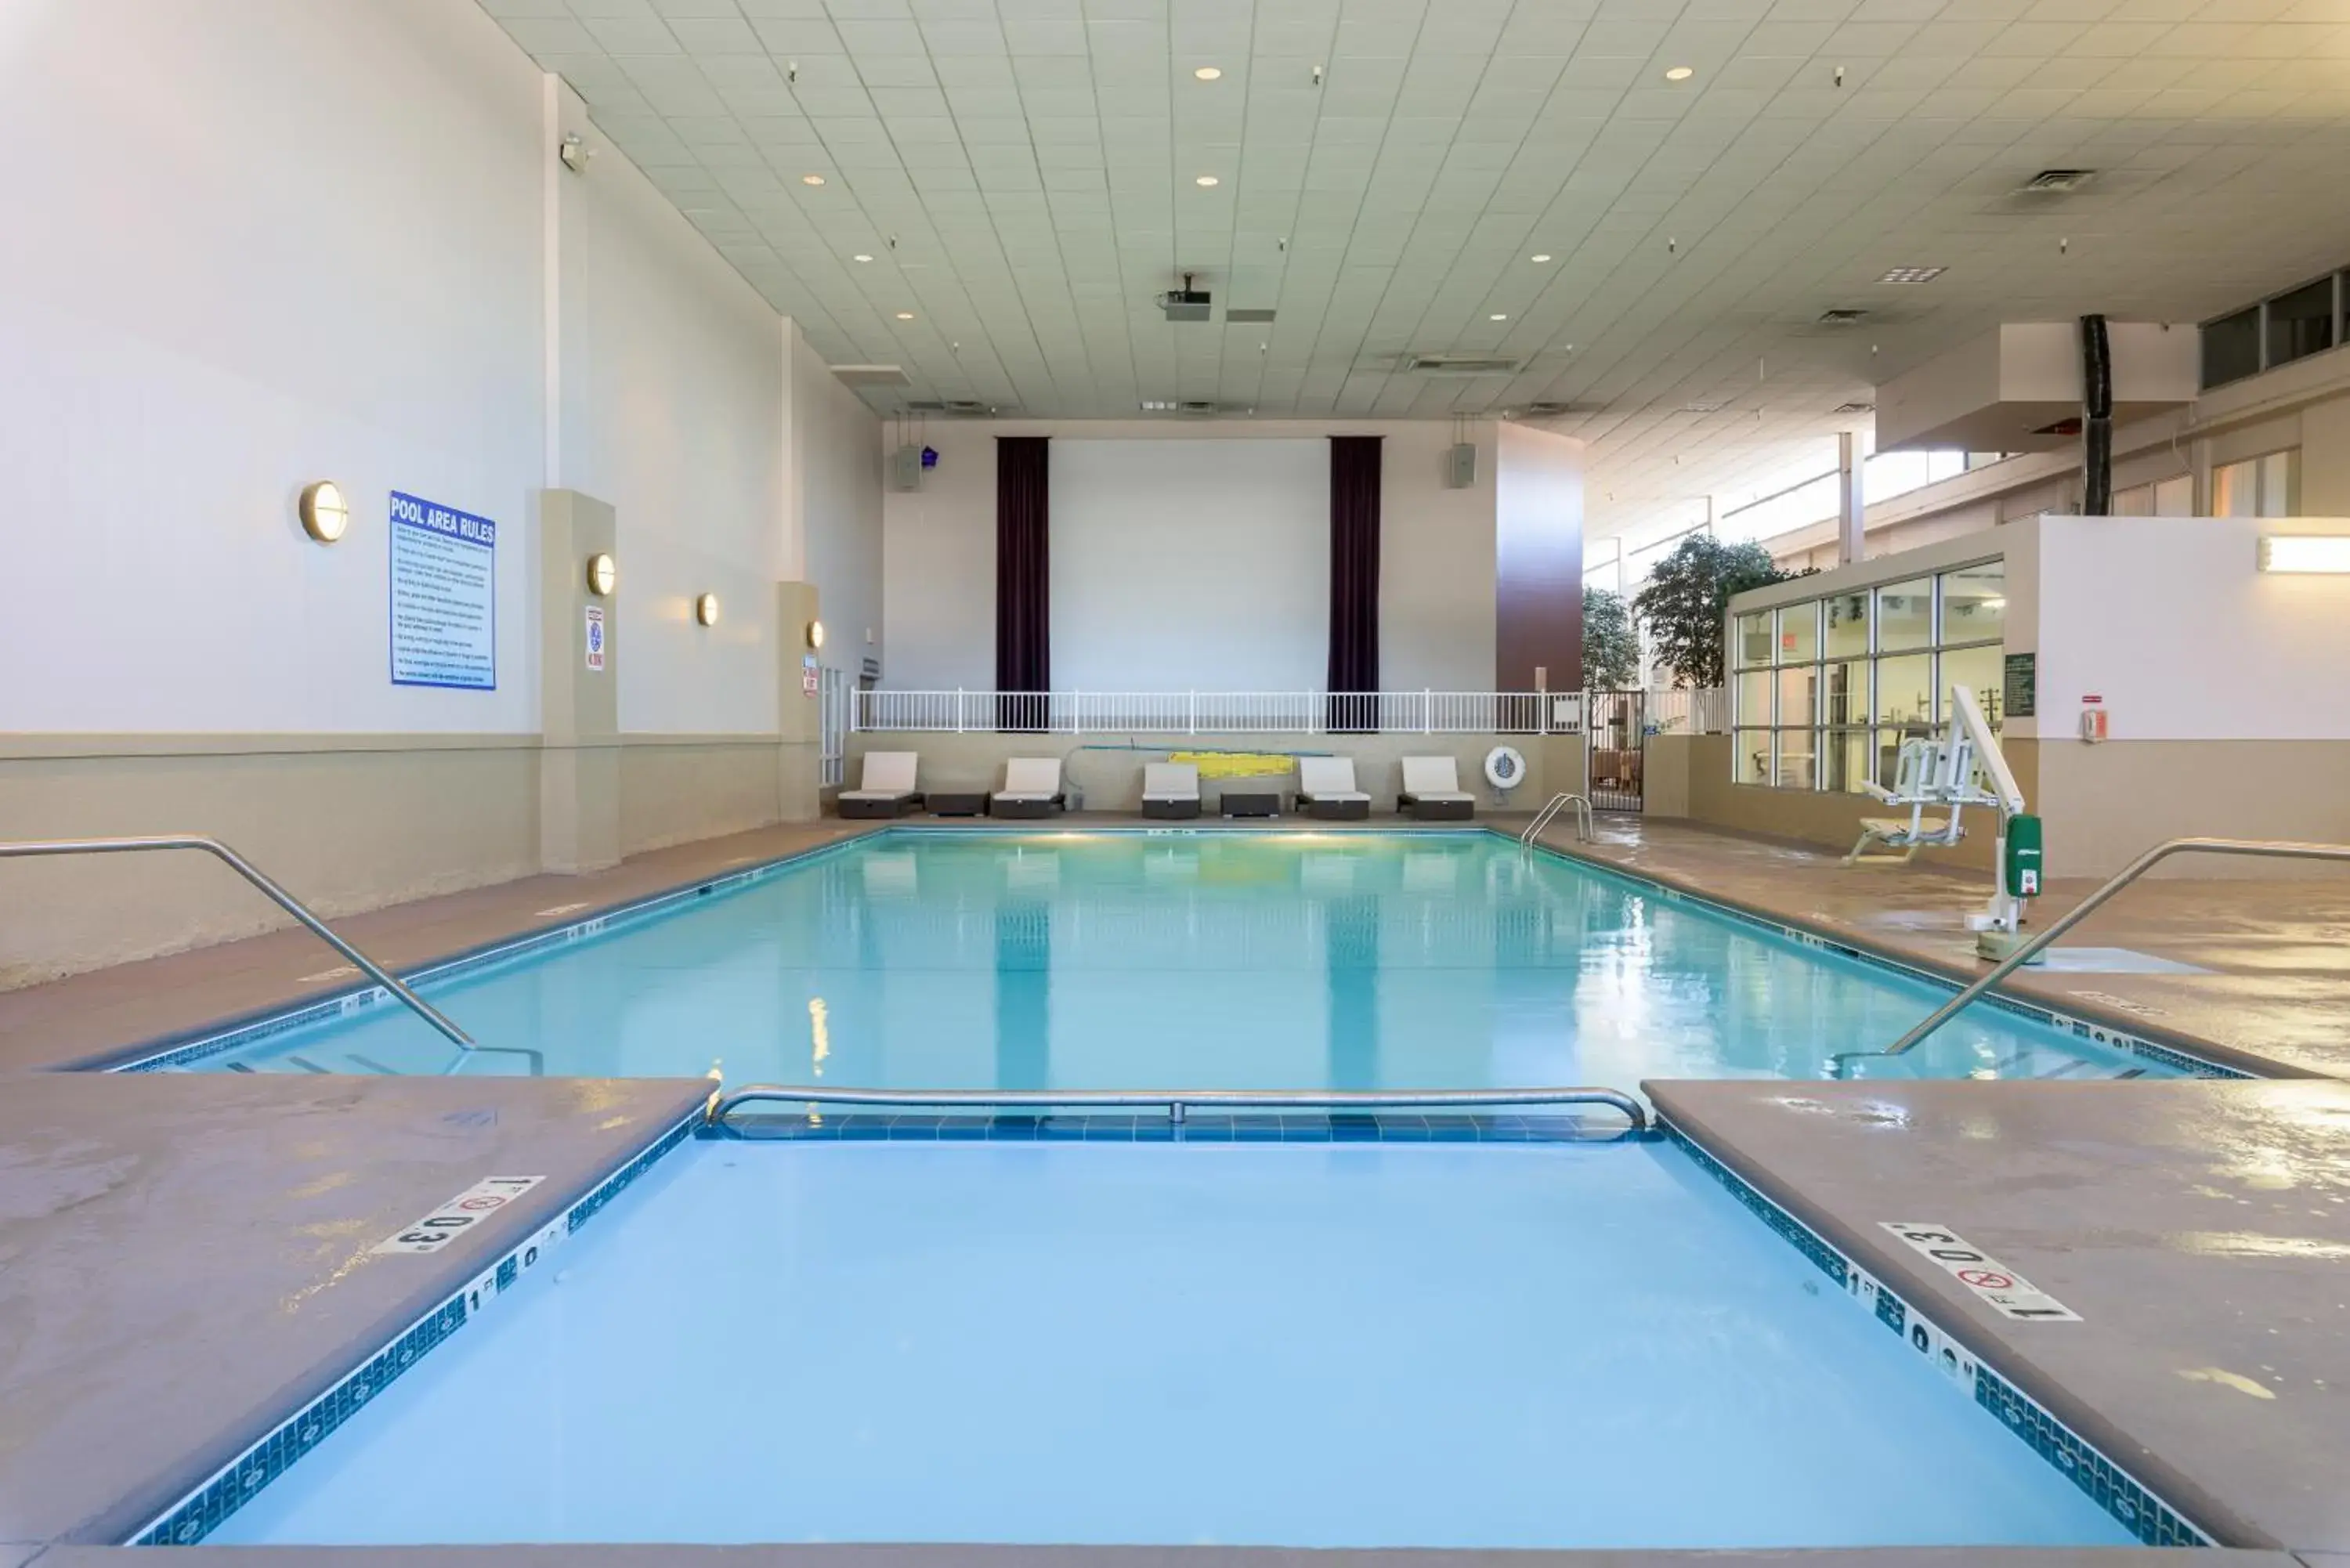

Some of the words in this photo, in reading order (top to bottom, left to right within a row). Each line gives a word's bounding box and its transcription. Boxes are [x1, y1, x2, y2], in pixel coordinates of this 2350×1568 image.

[391, 497, 425, 525] POOL
[427, 508, 458, 534] AREA
[460, 518, 494, 543] RULES
